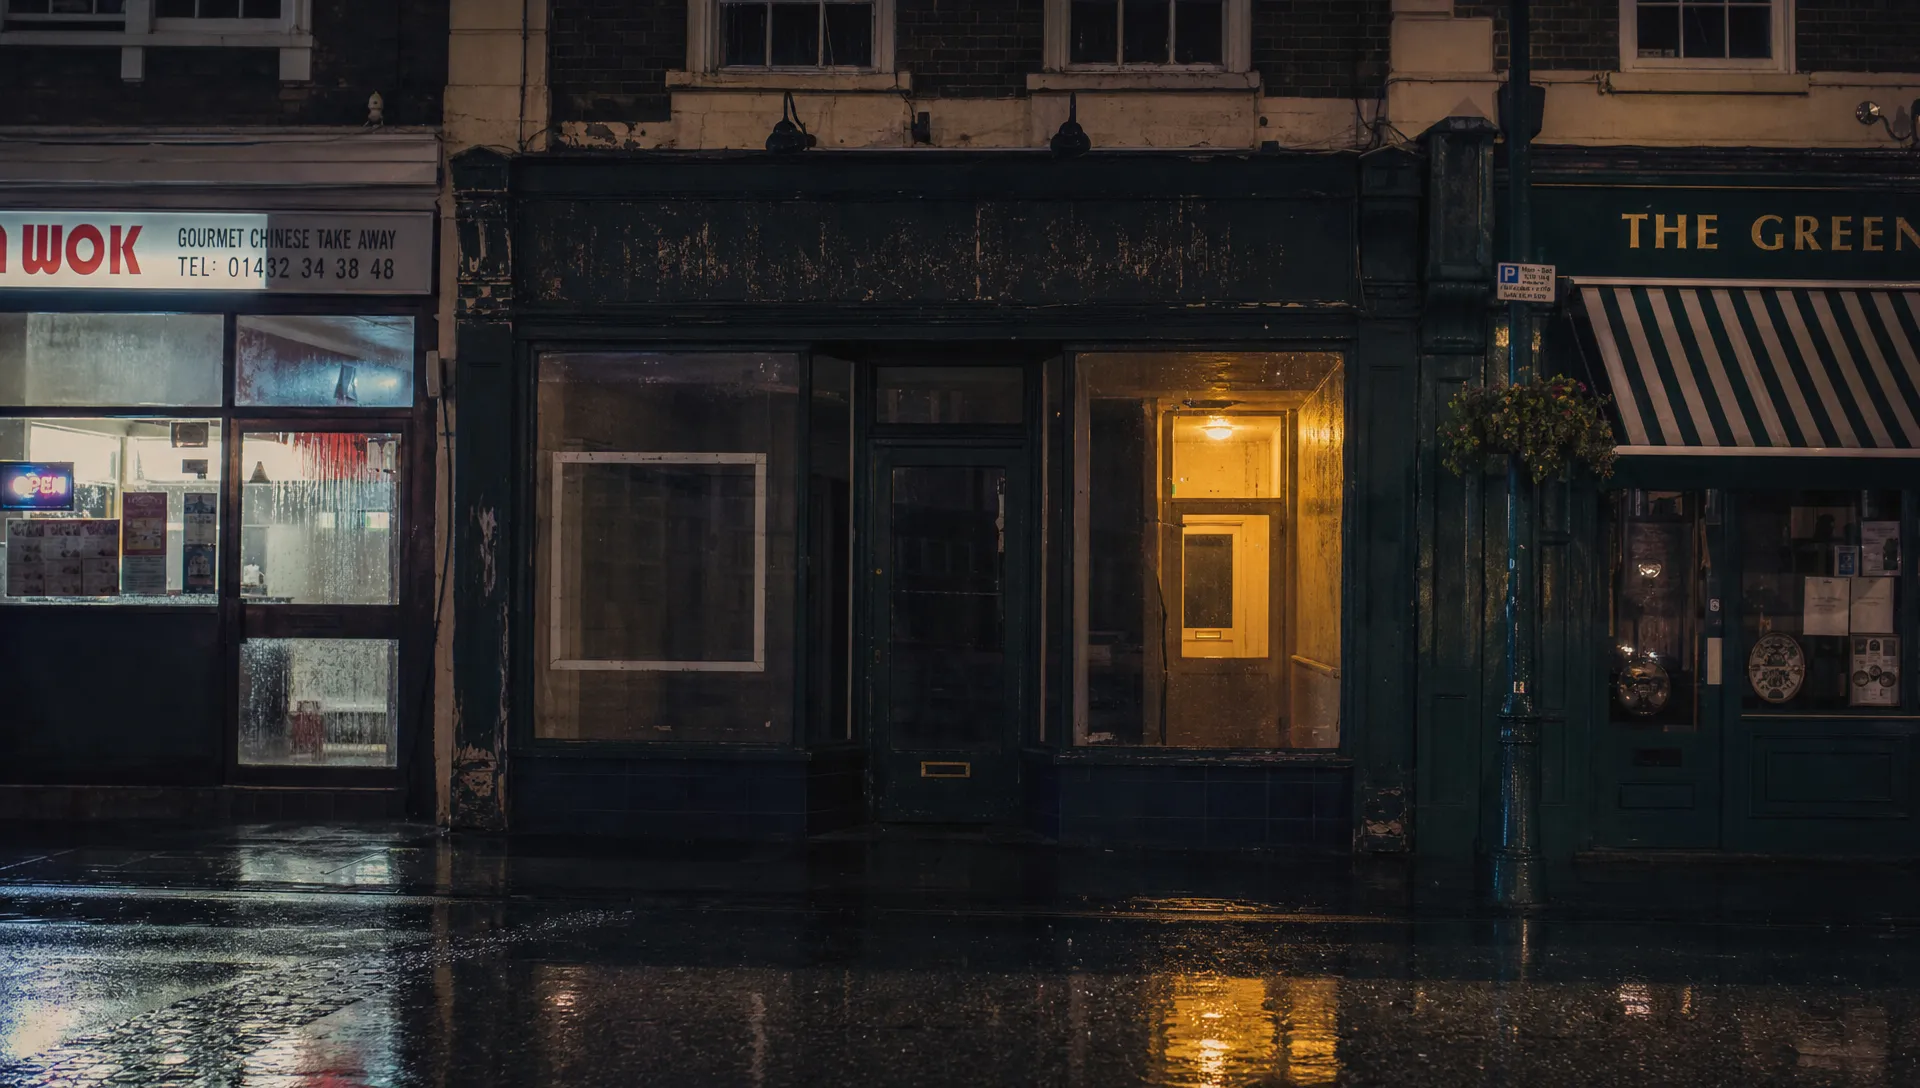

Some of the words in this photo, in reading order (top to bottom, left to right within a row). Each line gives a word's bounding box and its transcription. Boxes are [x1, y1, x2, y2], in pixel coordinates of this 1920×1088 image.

[178, 228, 244, 248] GOURMET
[250, 229, 310, 249] CHINESE
[318, 229, 351, 249] TAKE
[358, 229, 396, 250] AWAY
[1621, 213, 1719, 249] THE
[1751, 214, 1920, 251] GREEN
[22, 224, 142, 275] WOK
[178, 256, 217, 277] TEL:
[228, 257, 290, 278] 01432
[301, 257, 325, 279] 34
[336, 257, 360, 279] 38
[370, 257, 394, 280] 48
[1504, 267, 1516, 281] P
[13, 475, 66, 496] OPEN
